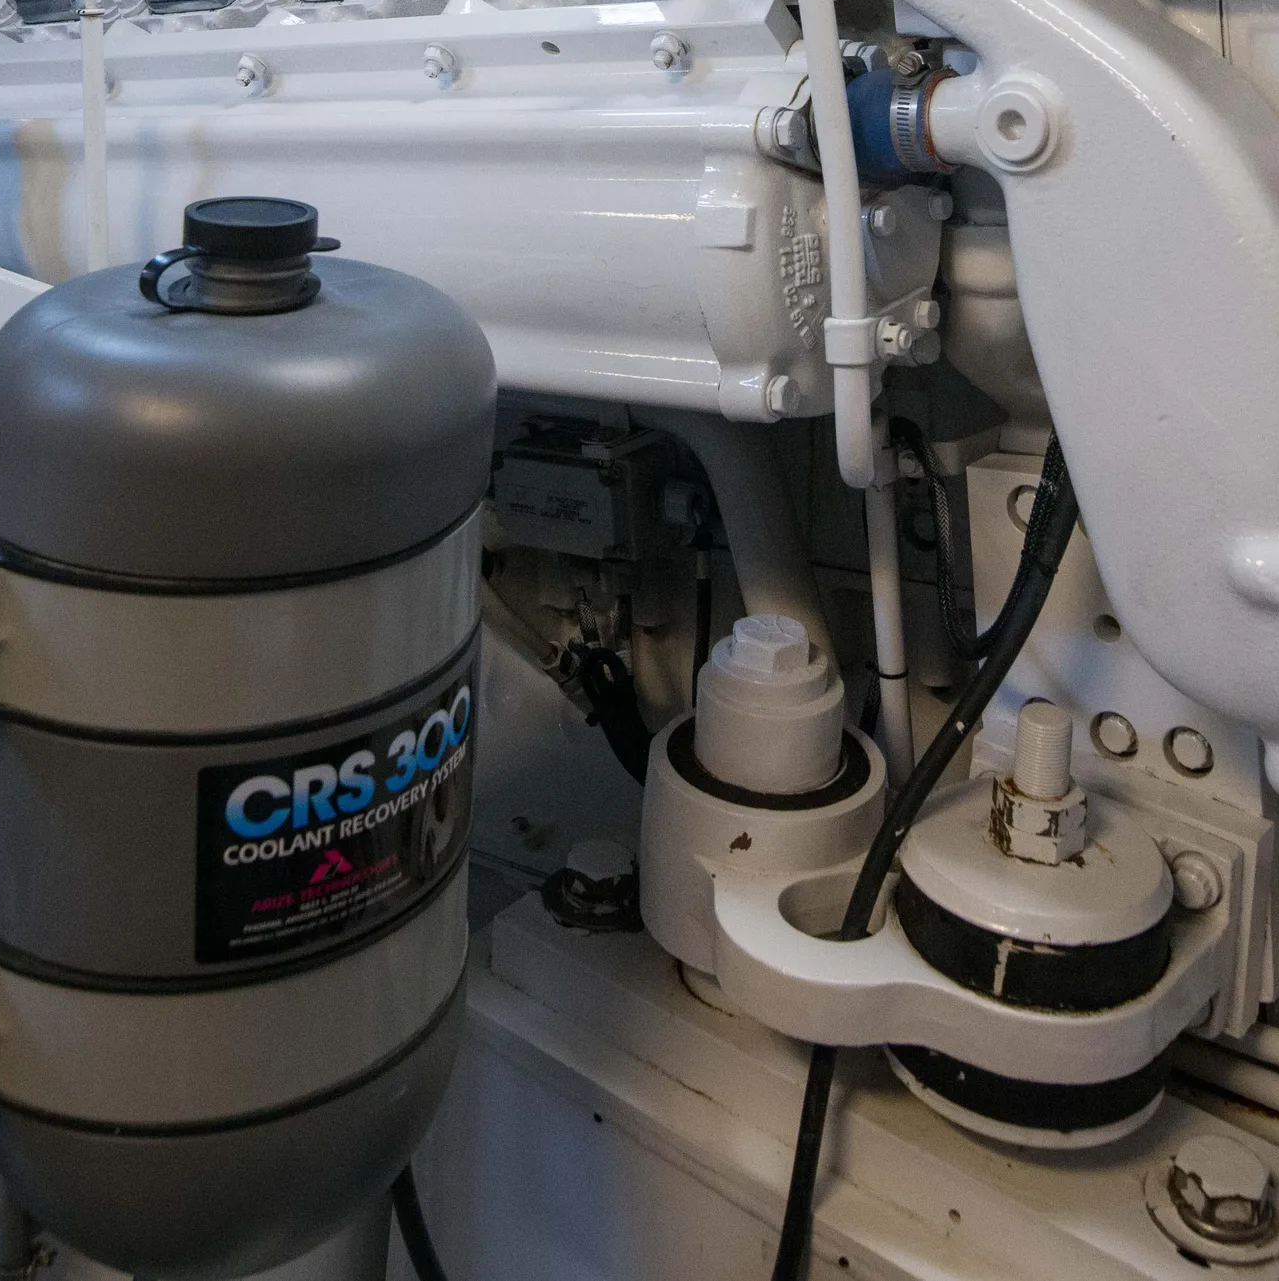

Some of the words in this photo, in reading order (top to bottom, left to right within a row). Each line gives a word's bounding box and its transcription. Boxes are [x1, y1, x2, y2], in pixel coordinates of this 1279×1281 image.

[223, 822, 336, 866] COOLANT
[339, 780, 430, 839] RECOVERY
[431, 742, 467, 794] SYSTEM
[225, 749, 376, 839] CRS
[385, 684, 470, 793] 300
